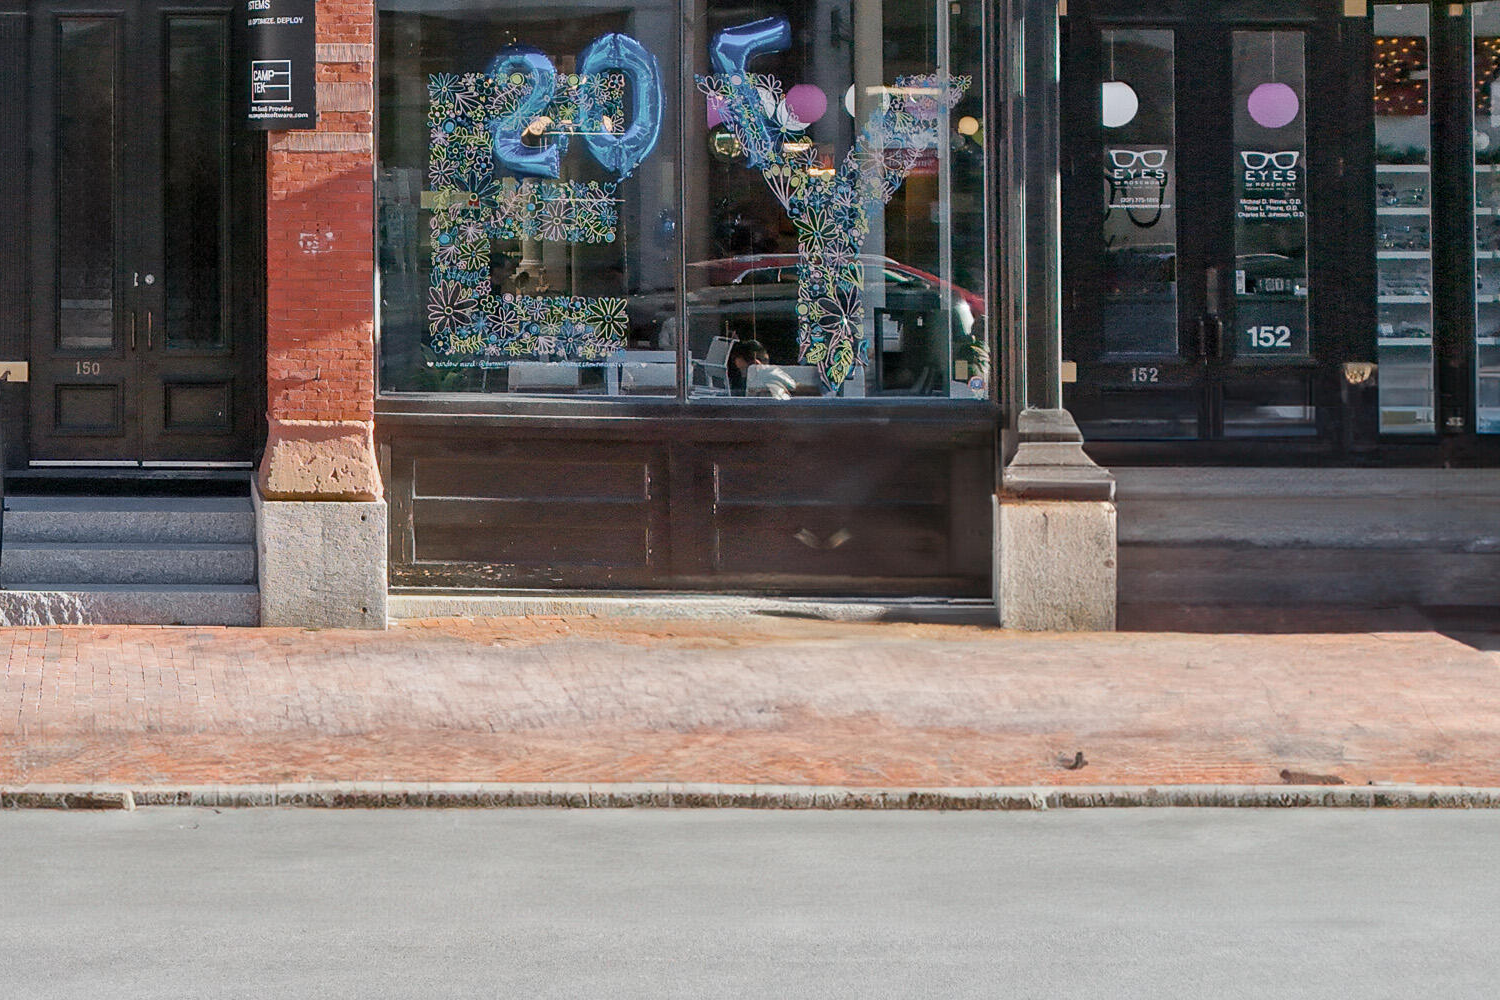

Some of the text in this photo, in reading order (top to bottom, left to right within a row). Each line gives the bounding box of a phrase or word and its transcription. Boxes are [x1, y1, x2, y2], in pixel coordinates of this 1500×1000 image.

[276, 15, 304, 24] DEPLOY
[253, 69, 275, 81] CAMP
[253, 82, 266, 93] TEK
[1114, 168, 1165, 179] EYES
[1245, 170, 1297, 181] EYES
[1246, 325, 1292, 348] 152
[75, 361, 100, 376] 150
[1130, 367, 1159, 383] 152
